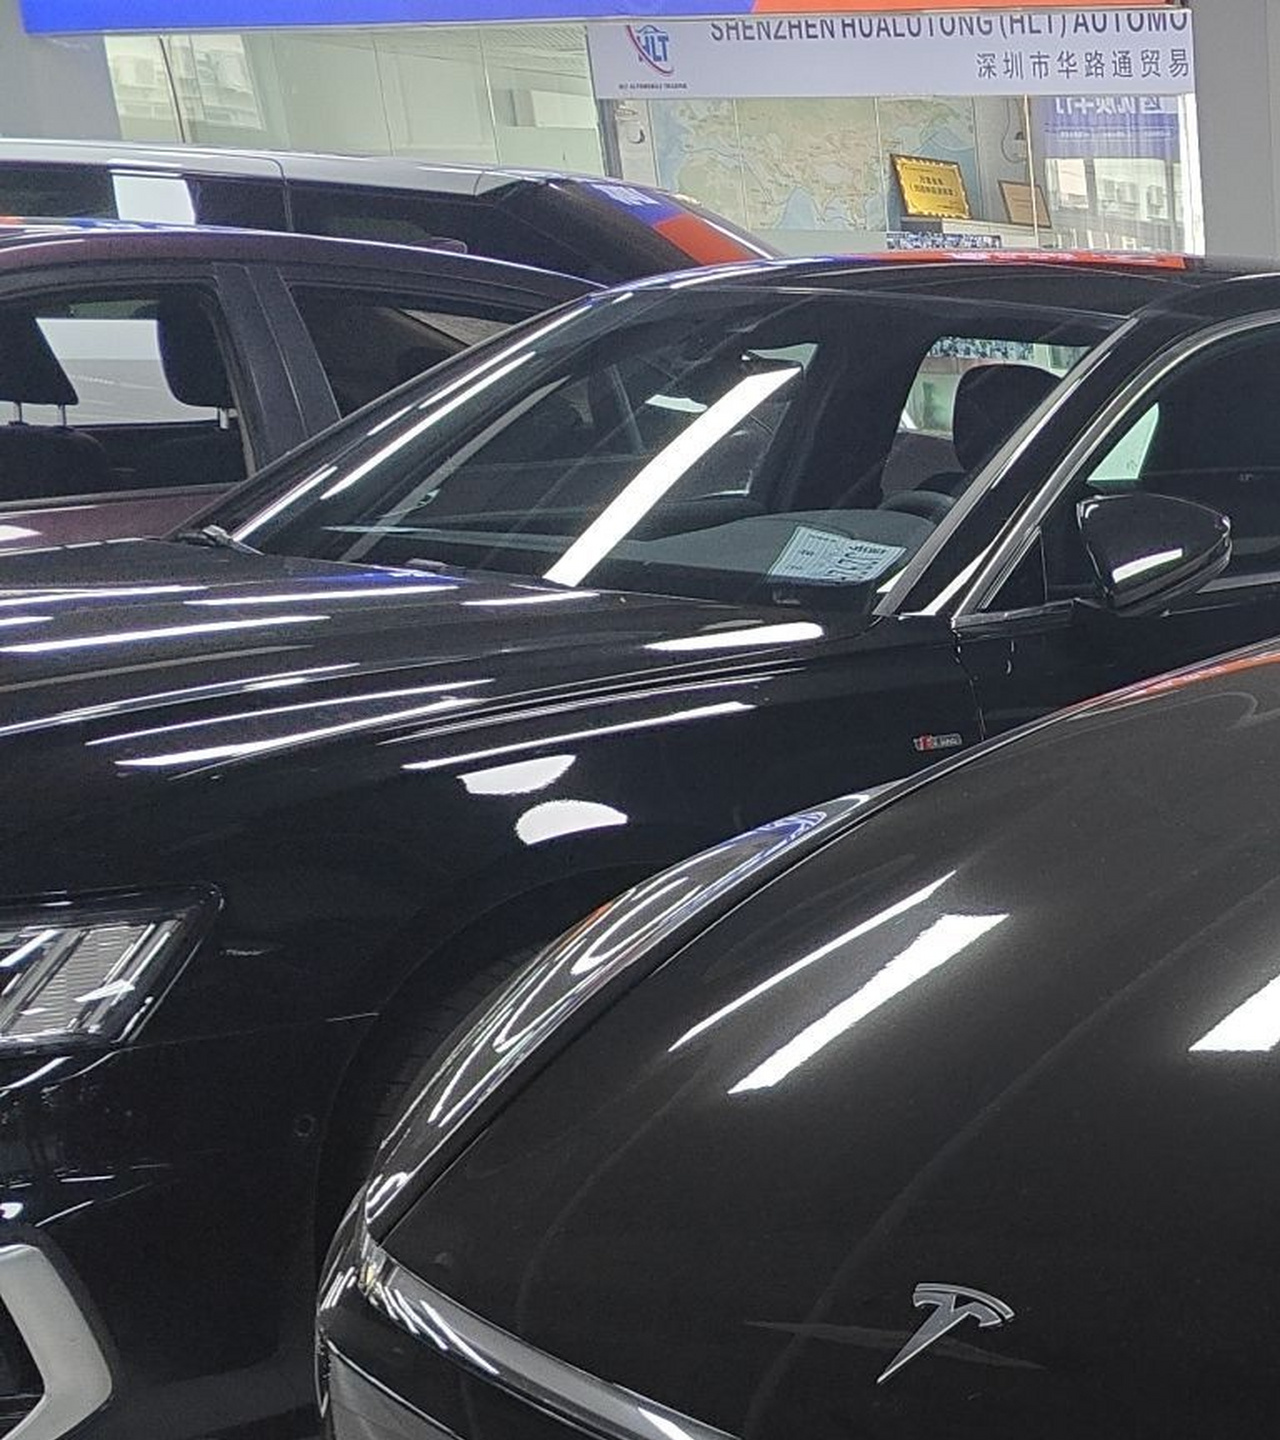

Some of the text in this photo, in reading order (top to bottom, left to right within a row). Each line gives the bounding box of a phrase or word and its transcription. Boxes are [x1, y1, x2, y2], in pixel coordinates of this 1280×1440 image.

[711, 18, 835, 41] SHENZHEN
[976, 48, 1189, 79] 深圳市华路通贸易
